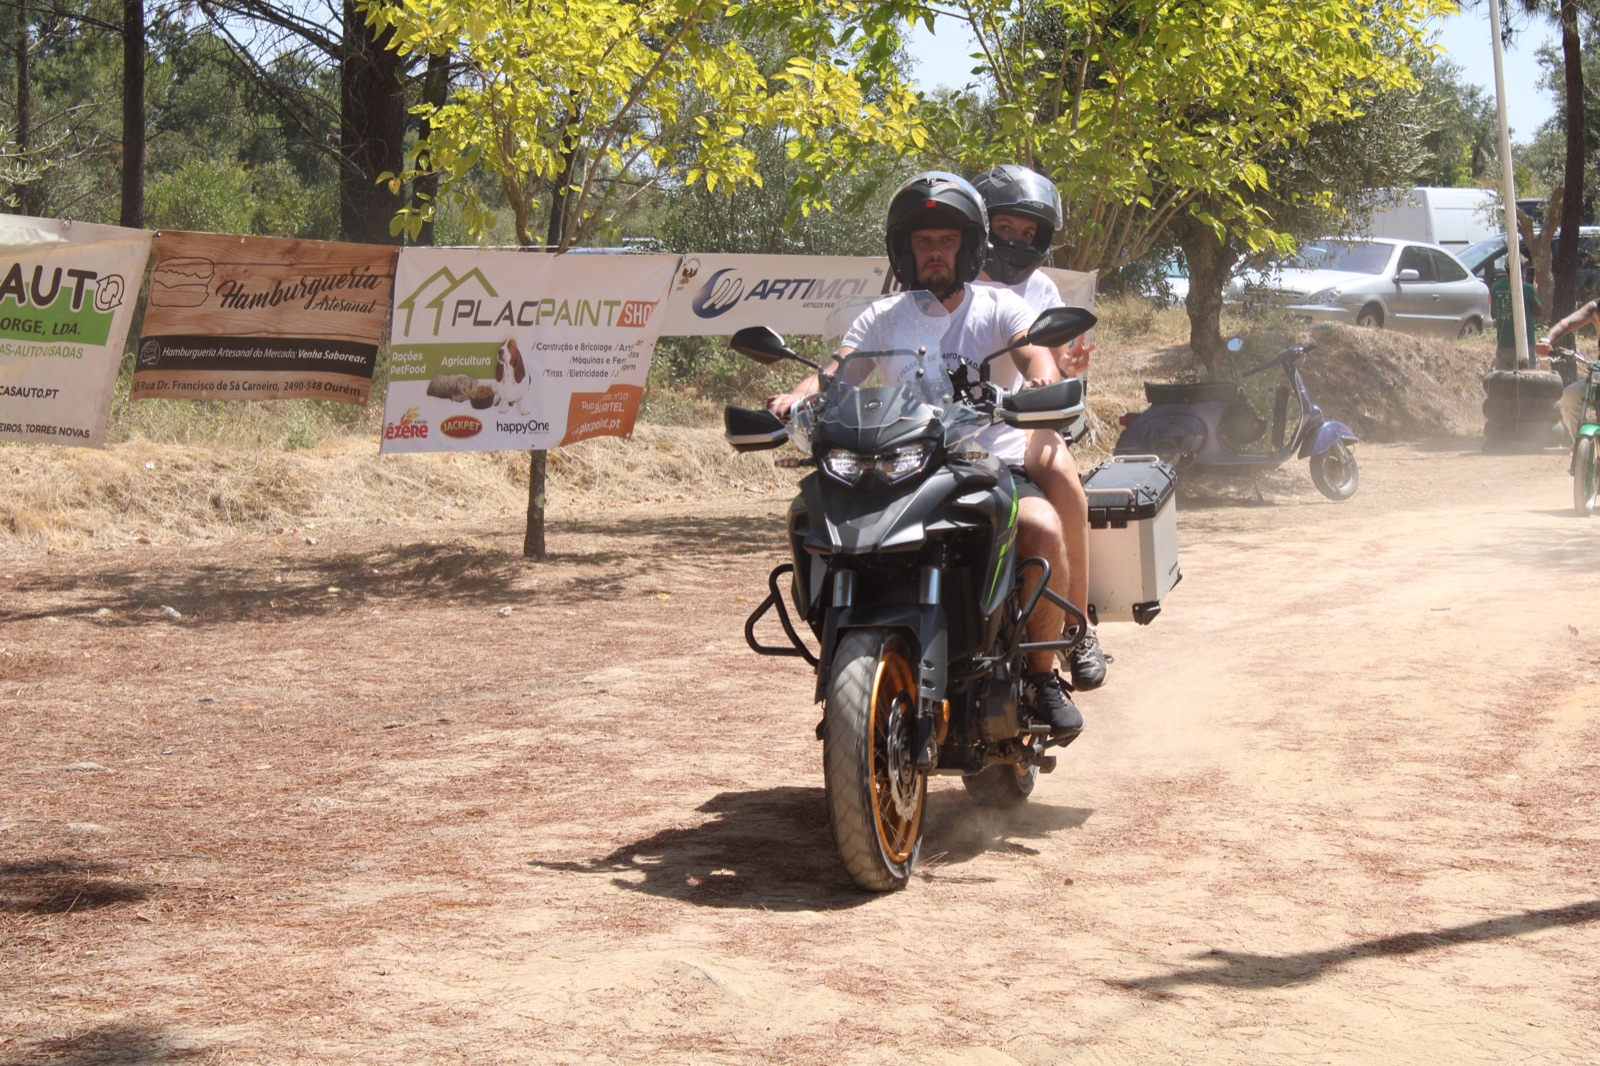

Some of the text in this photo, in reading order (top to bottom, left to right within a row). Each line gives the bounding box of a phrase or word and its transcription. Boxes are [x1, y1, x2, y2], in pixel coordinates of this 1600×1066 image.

[215, 265, 382, 311] Hamburgueria
[312, 296, 377, 314] Artesanal
[452, 298, 656, 327] PLACPAINT SHO
[52, 322, 81, 335] LDA.
[580, 342, 613, 352] Bricolage
[162, 347, 216, 359] Hamburgueria
[216, 347, 252, 357] Artesanal
[252, 348, 263, 357] do
[298, 348, 322, 359] Venha
[323, 350, 367, 364] Saborear.
[391, 350, 423, 363] Rações
[390, 364, 426, 375] PetFood
[140, 380, 361, 396] Rua Dr. Francisco de Sá Carneiro, 2490-548 Ourém
[25, 424, 57, 435] TORRES
[58, 427, 90, 439] NOVAS
[443, 420, 480, 432] JACKPET
[496, 419, 550, 434] happyOne
